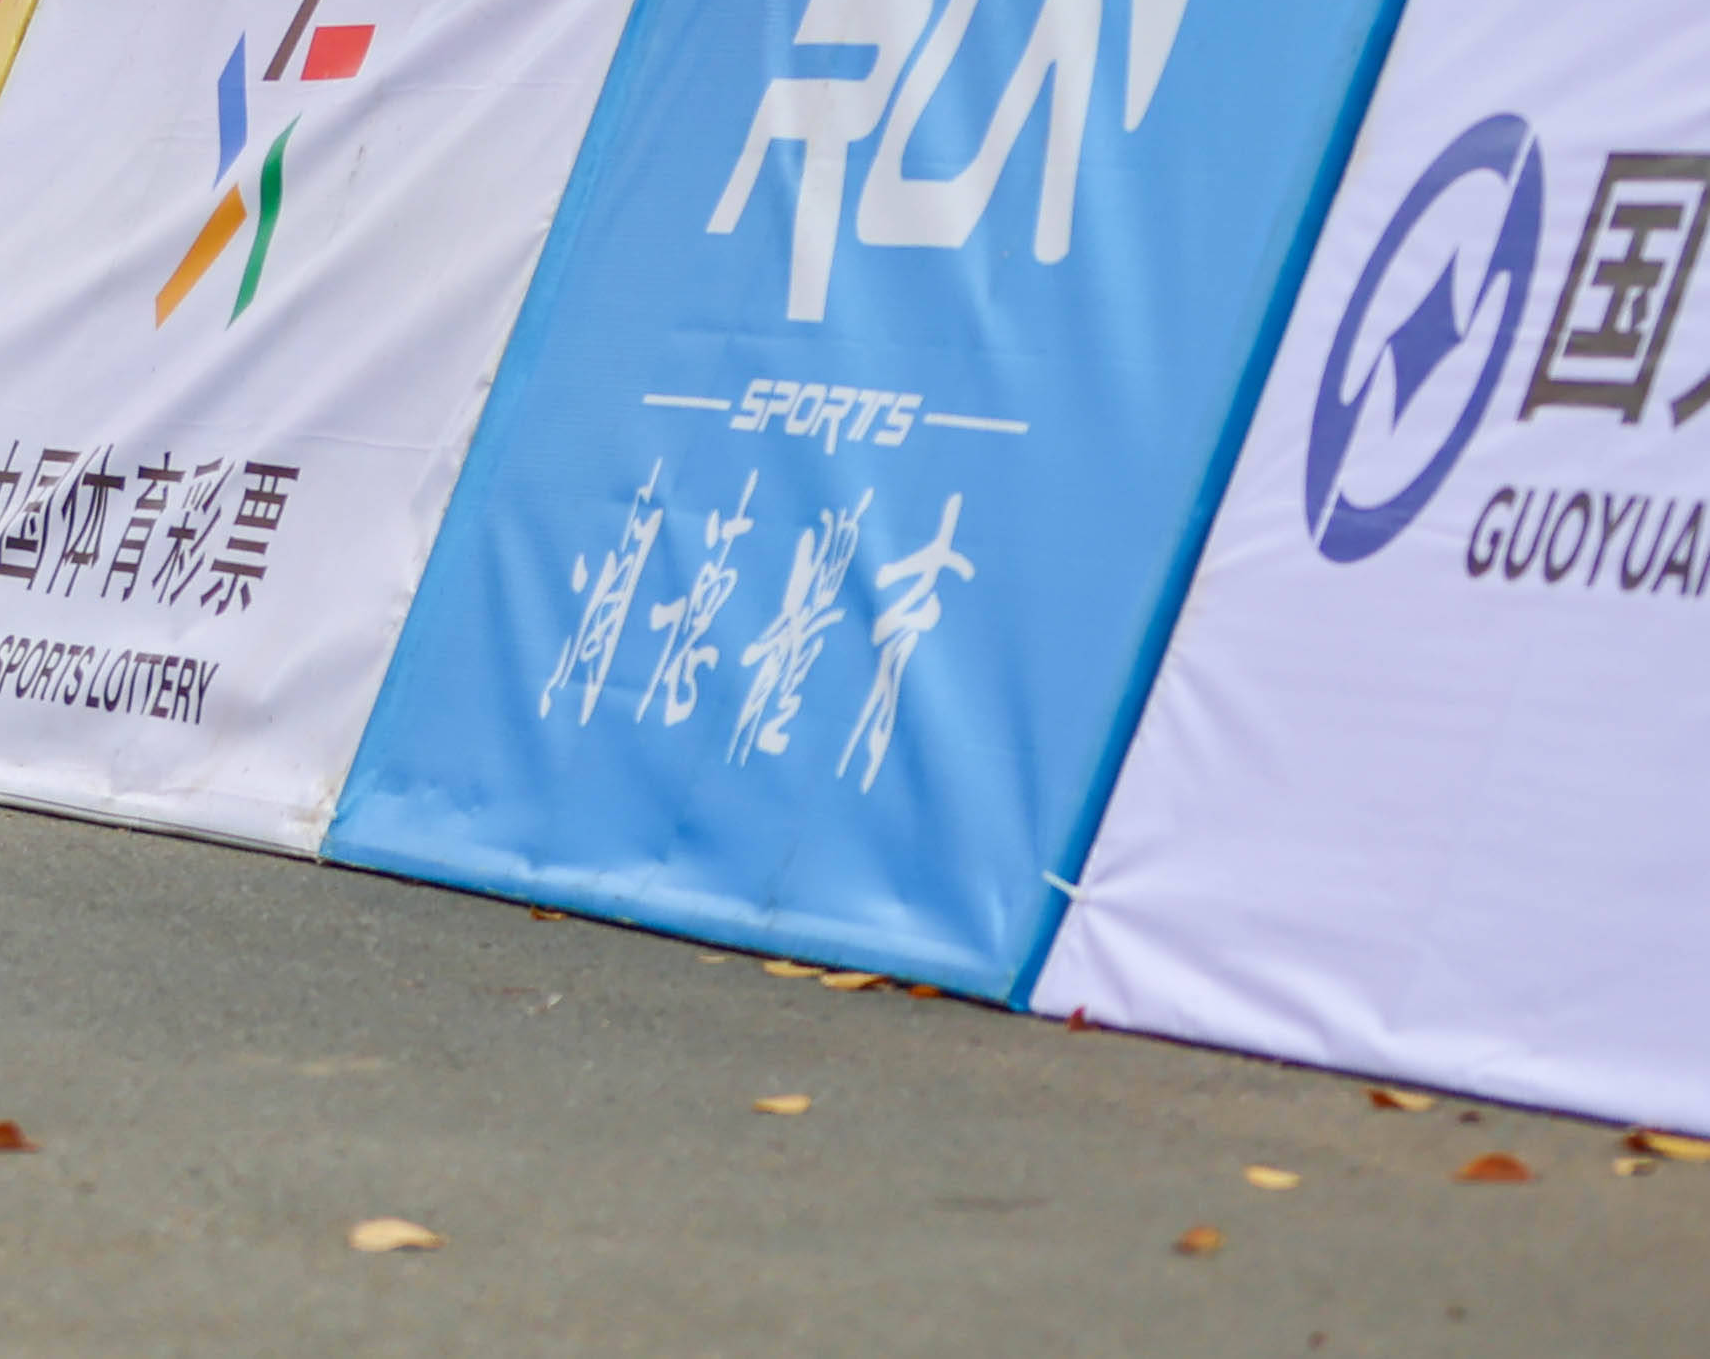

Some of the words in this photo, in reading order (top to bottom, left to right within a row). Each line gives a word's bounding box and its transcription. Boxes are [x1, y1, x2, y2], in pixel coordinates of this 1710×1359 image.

[1516, 151, 1710, 430] 国
[728, 377, 925, 456] SPORTS
[1465, 485, 1710, 599] GUOYUA
[84, 651, 221, 726] LOTTERY
